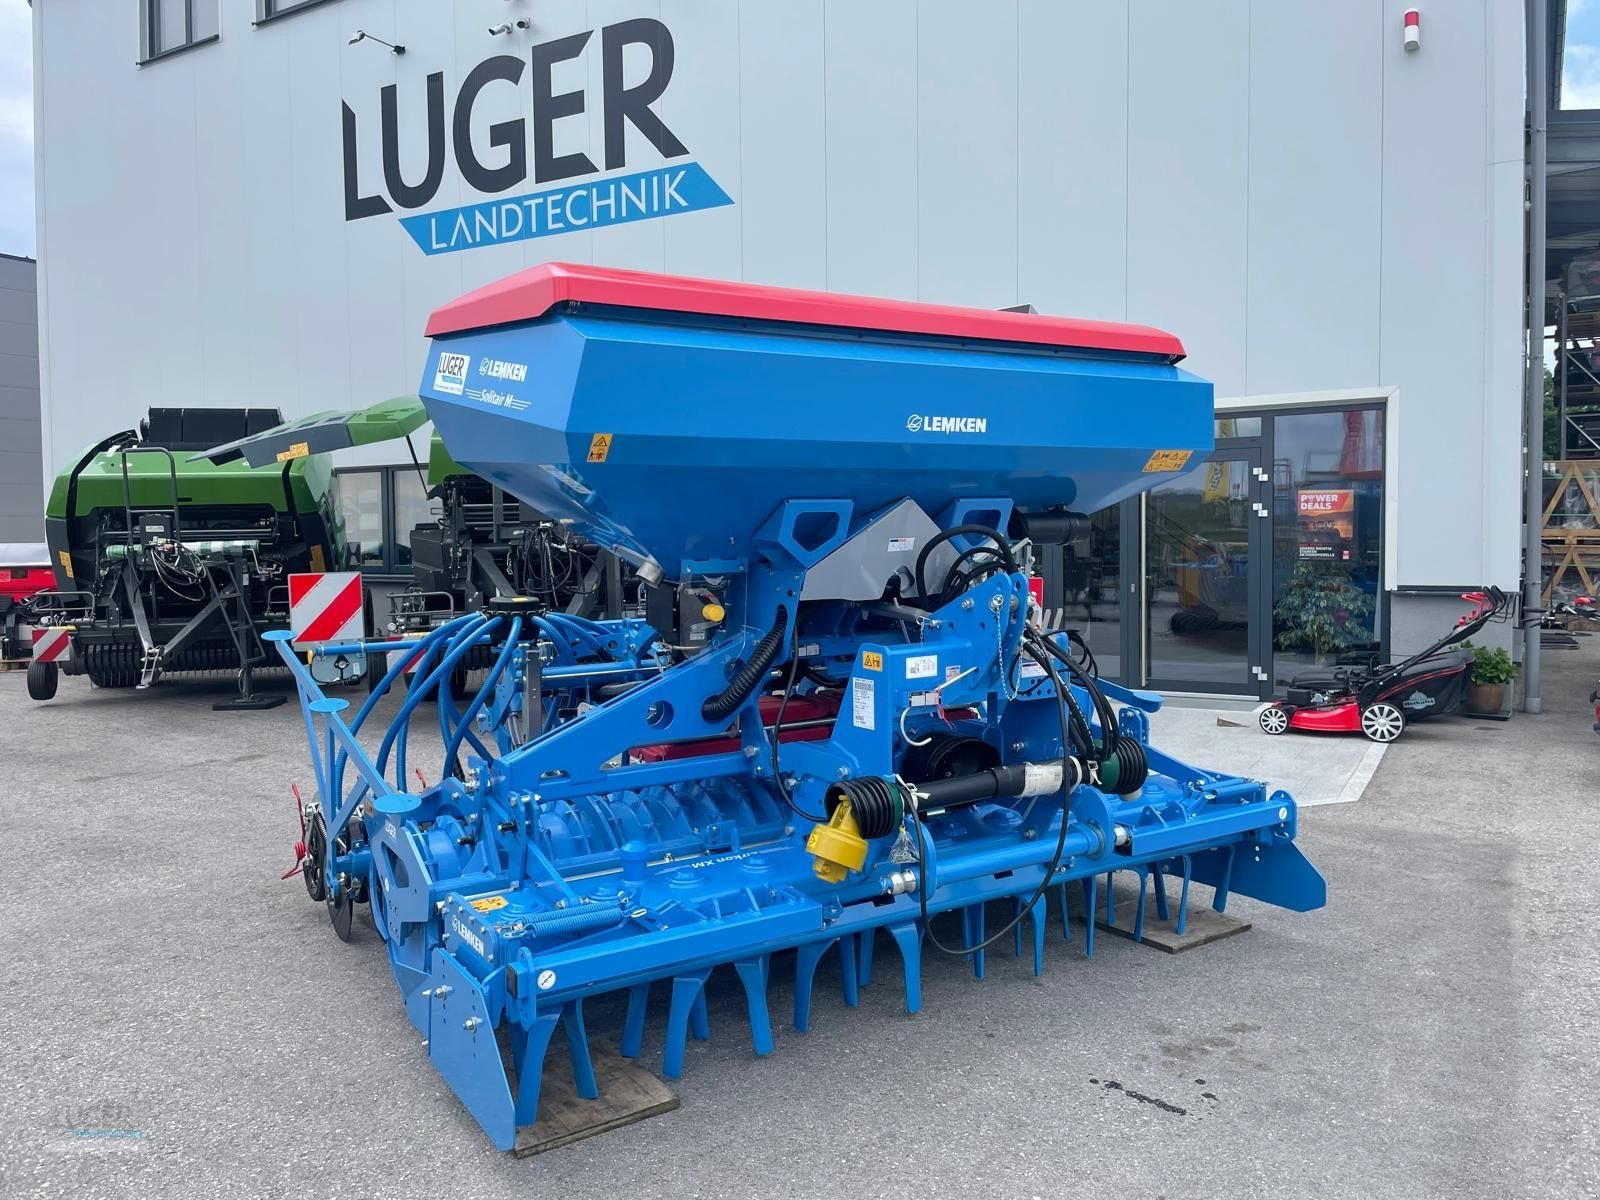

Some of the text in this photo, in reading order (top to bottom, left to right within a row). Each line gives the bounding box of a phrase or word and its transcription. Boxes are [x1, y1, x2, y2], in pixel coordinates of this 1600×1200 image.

[342, 18, 690, 221] LUGER
[431, 170, 688, 249] LANDTECHNIK
[438, 355, 465, 377] LUGER
[487, 360, 528, 382] LEMKEN
[480, 389, 514, 408] Solitair M
[923, 416, 987, 435] LEMKEN
[1300, 502, 1332, 510] DEALS
[692, 859, 715, 869] XM
[457, 921, 485, 957] LEMKEN
